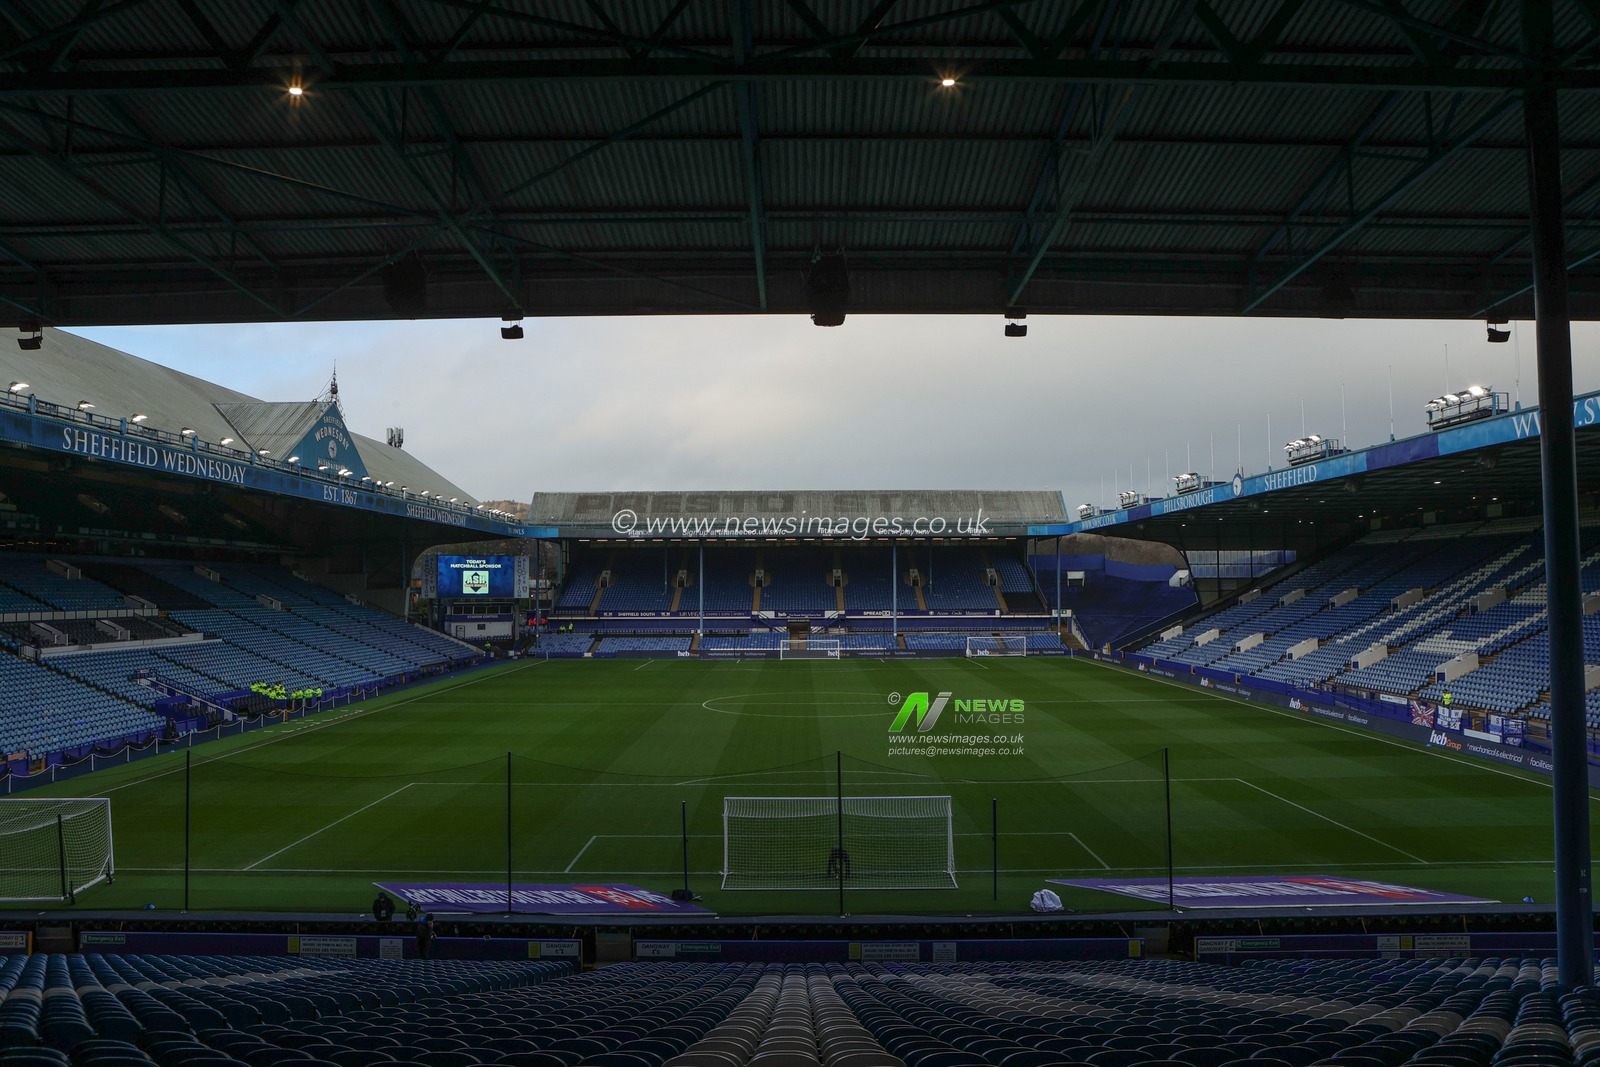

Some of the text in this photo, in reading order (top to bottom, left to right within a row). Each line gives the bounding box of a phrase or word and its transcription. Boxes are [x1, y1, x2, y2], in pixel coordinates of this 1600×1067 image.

[1511, 396, 1600, 440] W.S
[315, 426, 349, 450] WEDNESDAY
[62, 427, 246, 484] SHEFFIELD WEDNESDAY
[1264, 465, 1317, 491] SHEFFIELD
[323, 485, 358, 505] EST. 1867
[1164, 488, 1214, 513] HILLSBOROUGH
[406, 504, 466, 526] SHEFFIELD WEDNESDAY
[467, 575, 486, 584] ASH
[1289, 697, 1300, 710] heb
[1430, 730, 1447, 746] heb
[1446, 739, 1462, 750] Group
[1529, 757, 1553, 771] facilities
[1581, 869, 1586, 877] K
